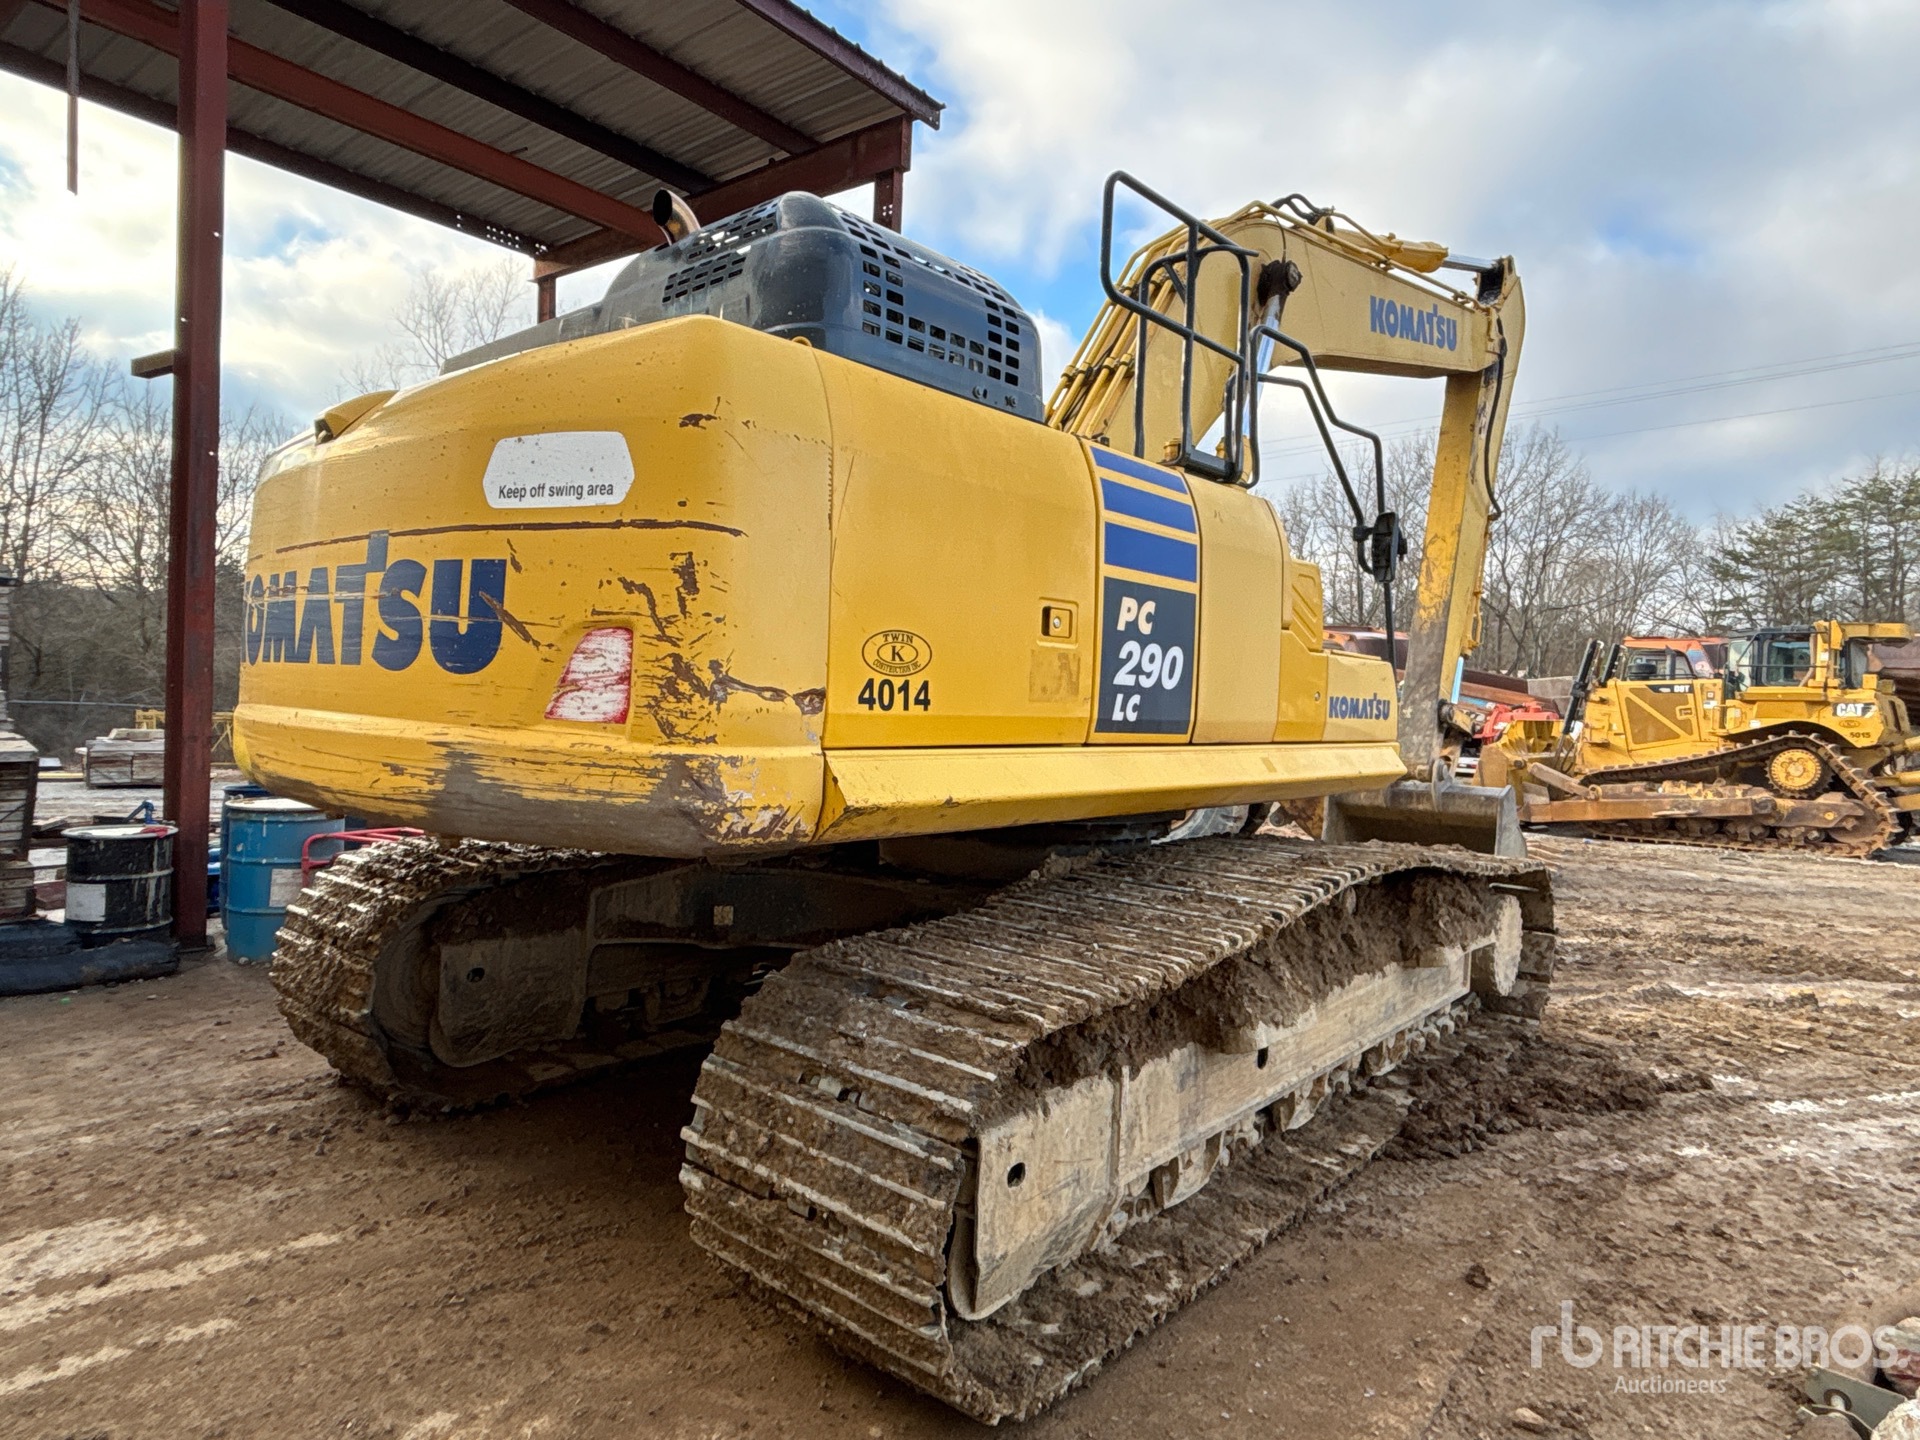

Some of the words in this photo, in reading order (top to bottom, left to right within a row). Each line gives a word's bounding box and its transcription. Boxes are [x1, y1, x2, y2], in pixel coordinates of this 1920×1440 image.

[1370, 295, 1457, 352] KOMATSU
[498, 485, 526, 502] Keep
[529, 483, 546, 499] off
[548, 483, 583, 500] swing
[587, 484, 614, 496] area
[241, 530, 507, 675] OMATSU
[1117, 596, 1156, 635] PC
[883, 633, 914, 644] TWIN
[891, 645, 905, 662] K
[1113, 640, 1184, 690] 290
[858, 678, 931, 711] 4014
[1112, 693, 1141, 722] LC
[1329, 692, 1390, 720] KOMATSU
[1836, 703, 1864, 717] CAT
